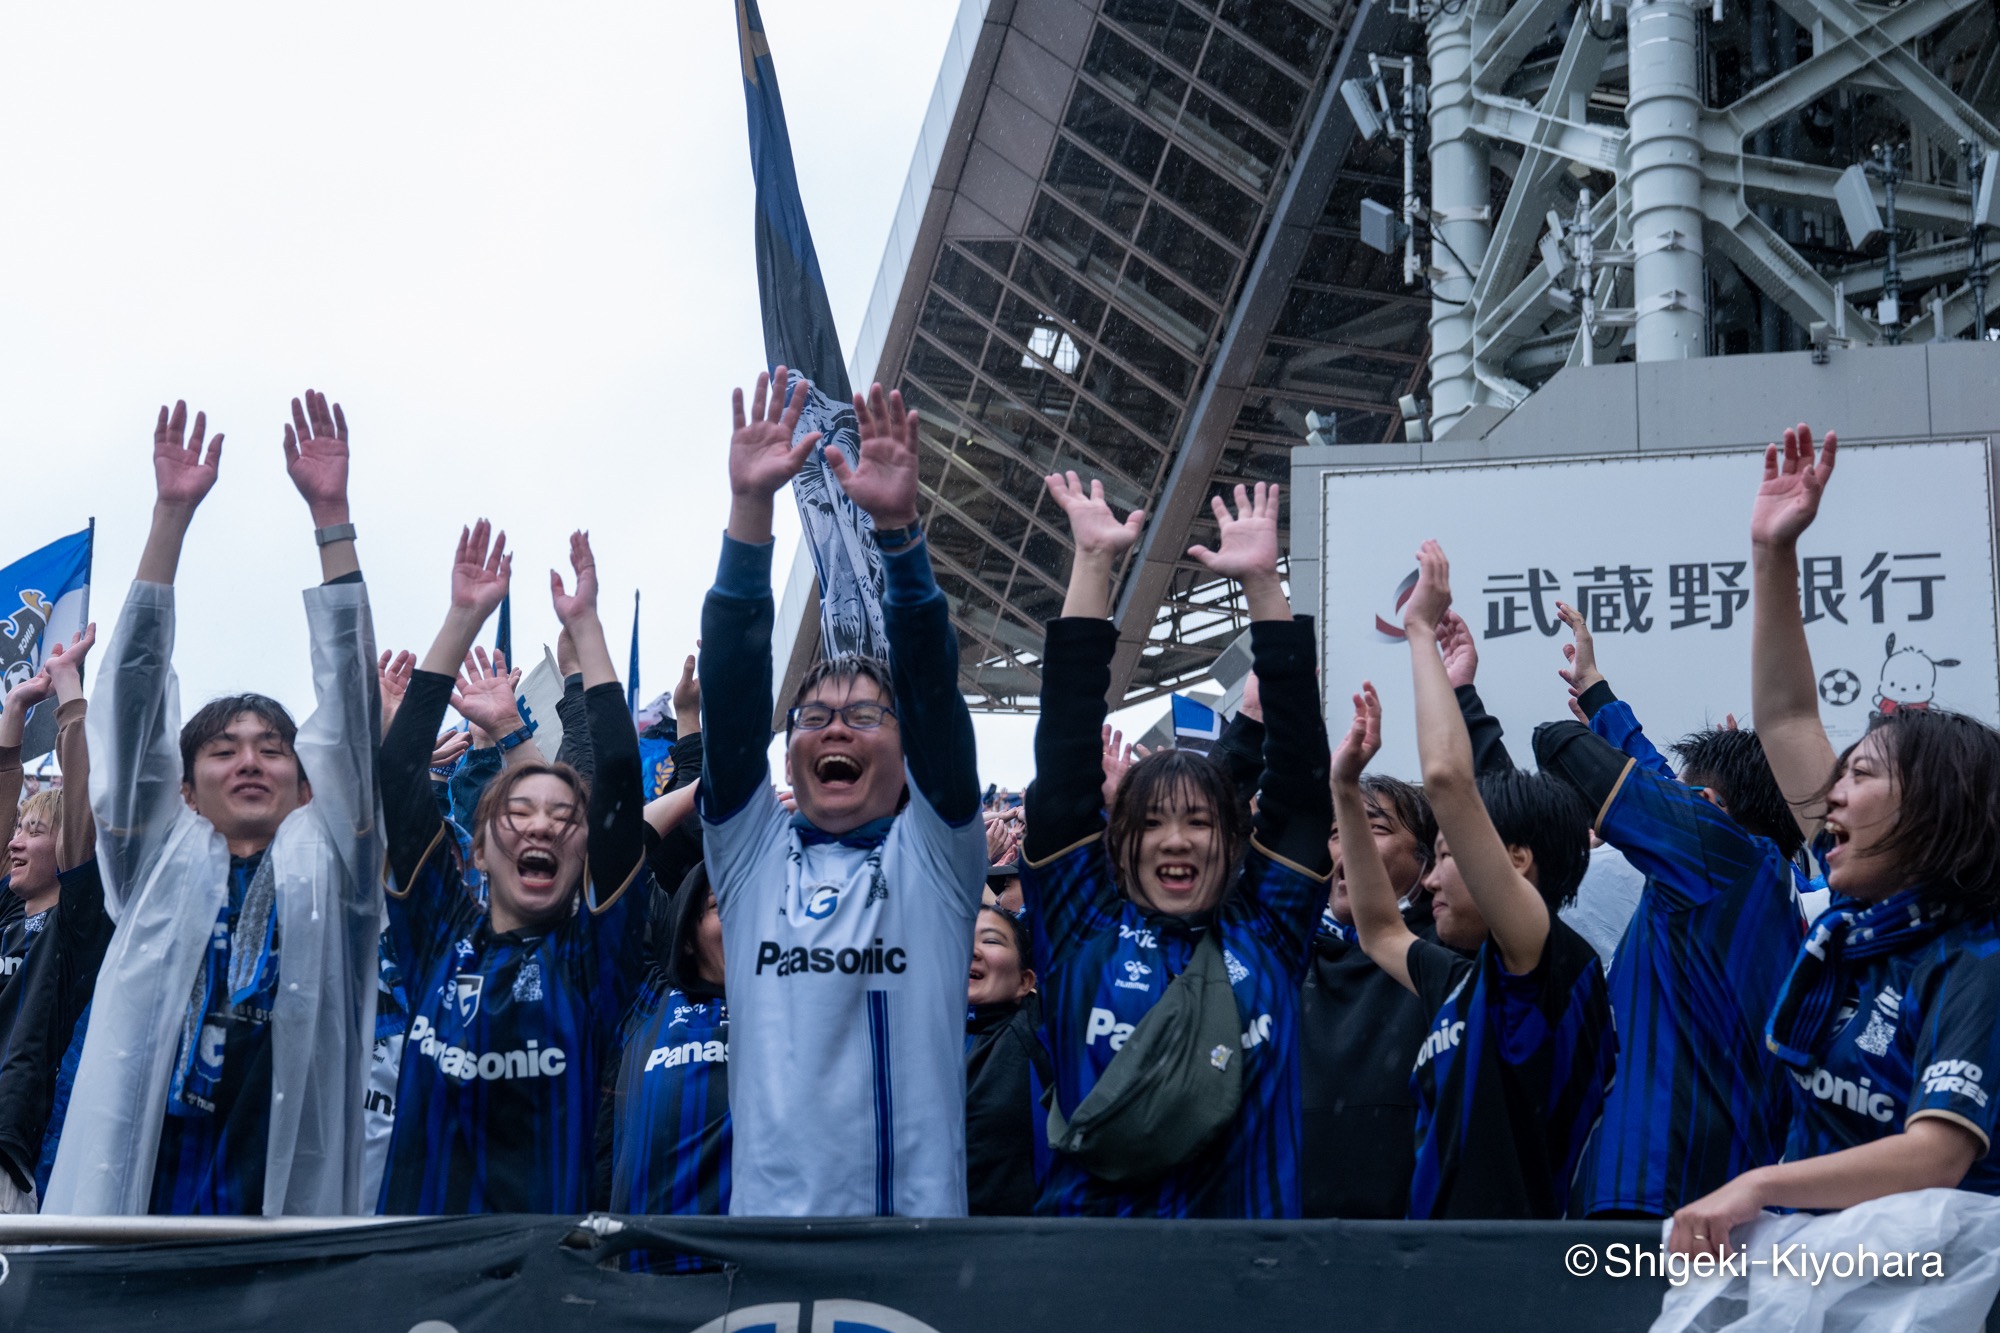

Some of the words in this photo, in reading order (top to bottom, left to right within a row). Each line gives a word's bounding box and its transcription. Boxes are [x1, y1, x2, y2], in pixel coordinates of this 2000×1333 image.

[1114, 978, 1150, 992] hummel
[406, 1014, 567, 1081] Panasonic
[1921, 1058, 1984, 1083] TOYO
[1924, 1076, 1989, 1108] TIRES
